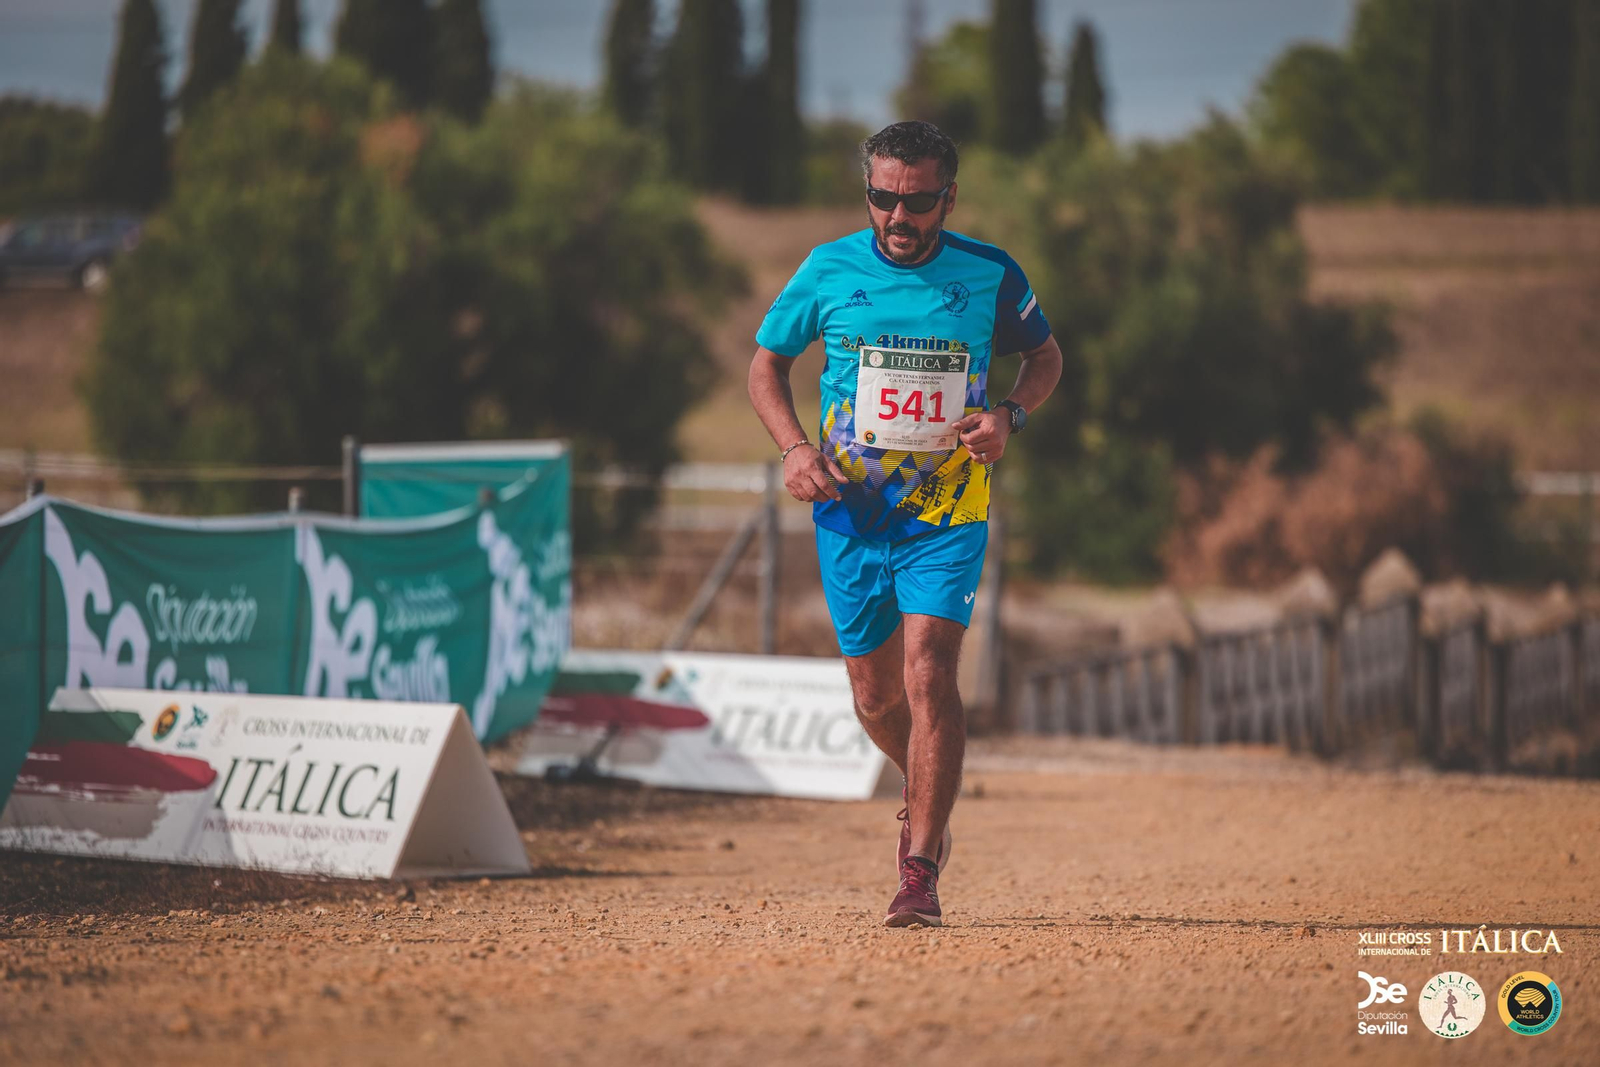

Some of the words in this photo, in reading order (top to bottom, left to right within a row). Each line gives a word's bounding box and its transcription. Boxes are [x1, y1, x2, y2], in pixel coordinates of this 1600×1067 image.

[890, 354, 942, 369] ITÁLICA
[878, 387, 946, 423] 541
[242, 716, 287, 738] CROSS
[289, 718, 407, 744] INTERNACIONAL
[409, 726, 430, 745] DE
[213, 742, 402, 821] ITÁLICA
